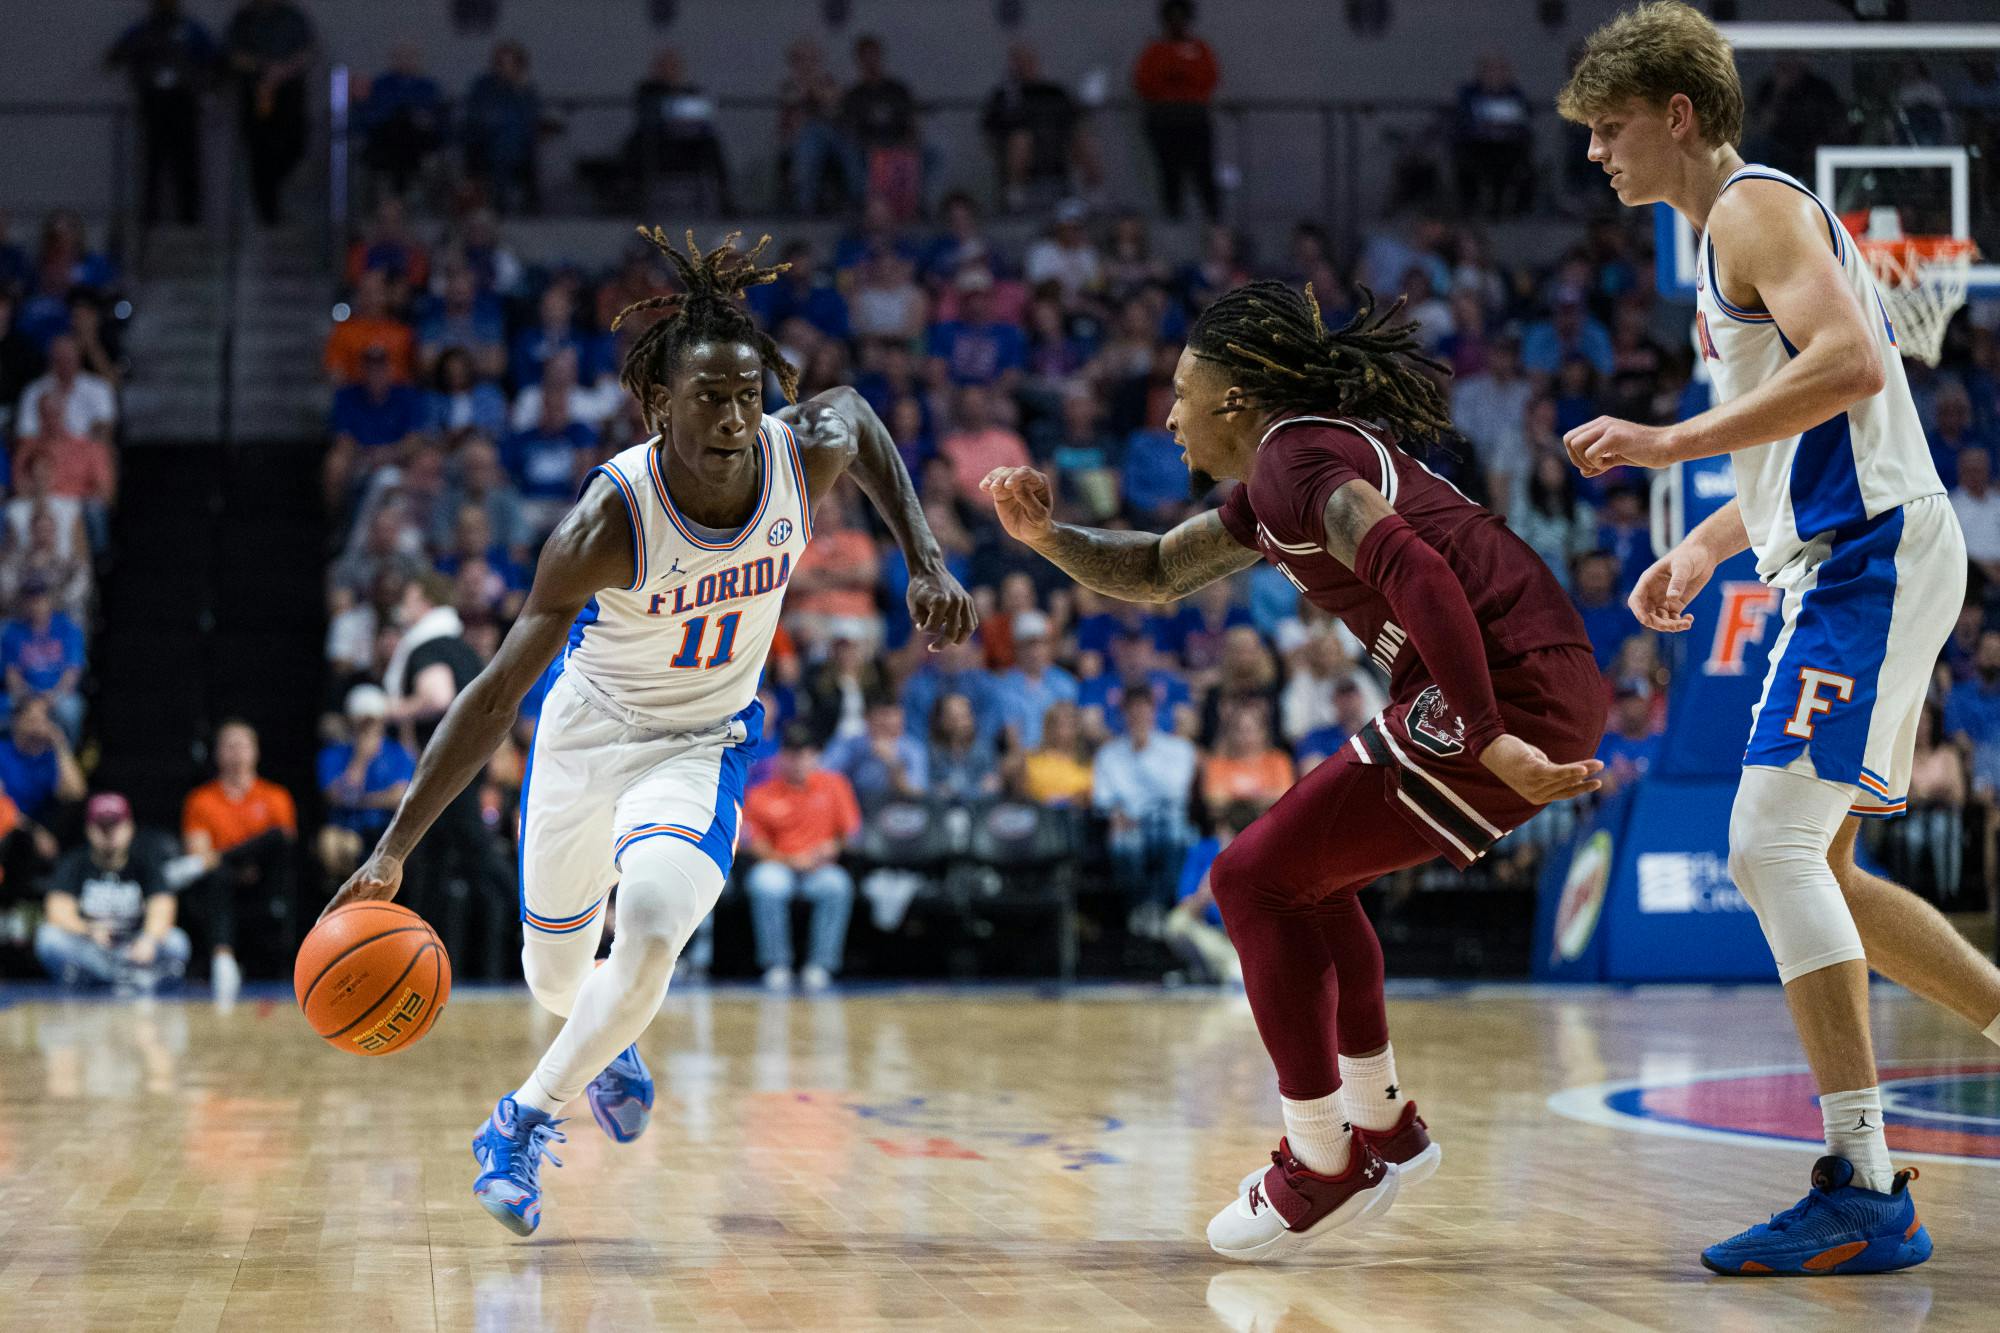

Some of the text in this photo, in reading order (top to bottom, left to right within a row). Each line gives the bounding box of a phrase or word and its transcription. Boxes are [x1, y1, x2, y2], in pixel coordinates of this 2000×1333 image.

[769, 519, 792, 546] SEC
[647, 552, 790, 615] FLORIDA
[670, 611, 742, 669] 11
[1706, 581, 1779, 676] F
[1784, 667, 1856, 741] F
[358, 992, 426, 1051] ELITE
